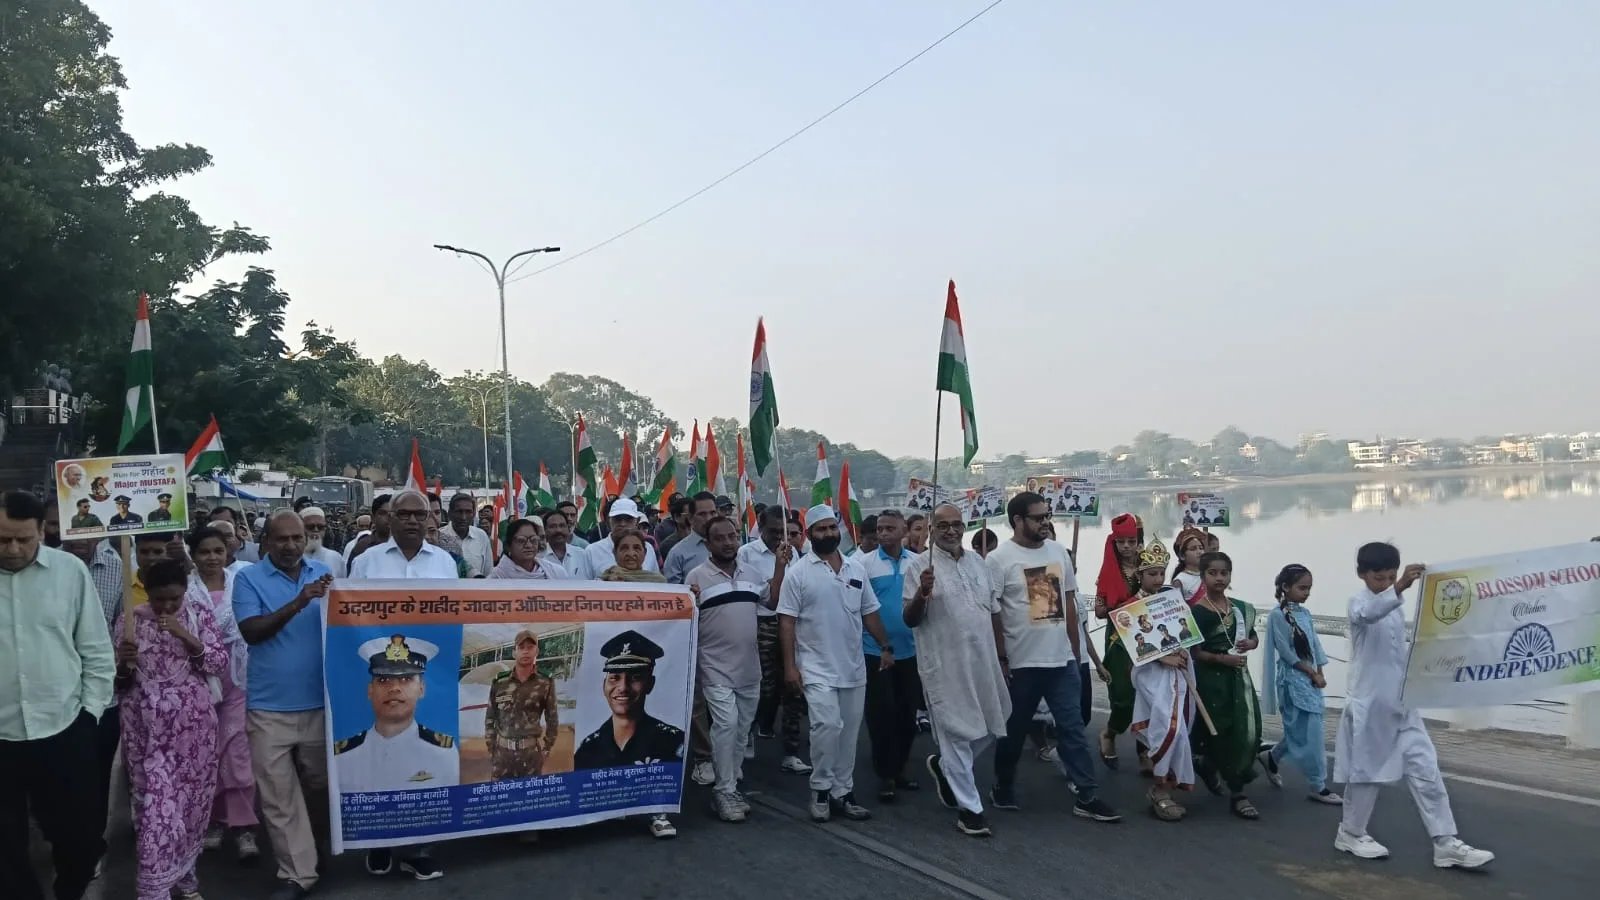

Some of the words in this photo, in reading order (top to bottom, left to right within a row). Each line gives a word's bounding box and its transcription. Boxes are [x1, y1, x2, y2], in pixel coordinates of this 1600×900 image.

[114, 480, 138, 489] Major
[140, 478, 177, 487] MUSTAFA
[1475, 571, 1546, 600] BLOSSOM
[339, 600, 399, 620] उदयपुर
[400, 596, 416, 614] के
[419, 595, 461, 616] शहीद
[515, 595, 572, 613] ऑफिसर
[574, 595, 603, 612] जिन
[605, 599, 624, 613] पर
[647, 600, 675, 613] नाज़
[1453, 645, 1597, 683] INDEPENDENCE
[391, 791, 421, 803] अभिनव
